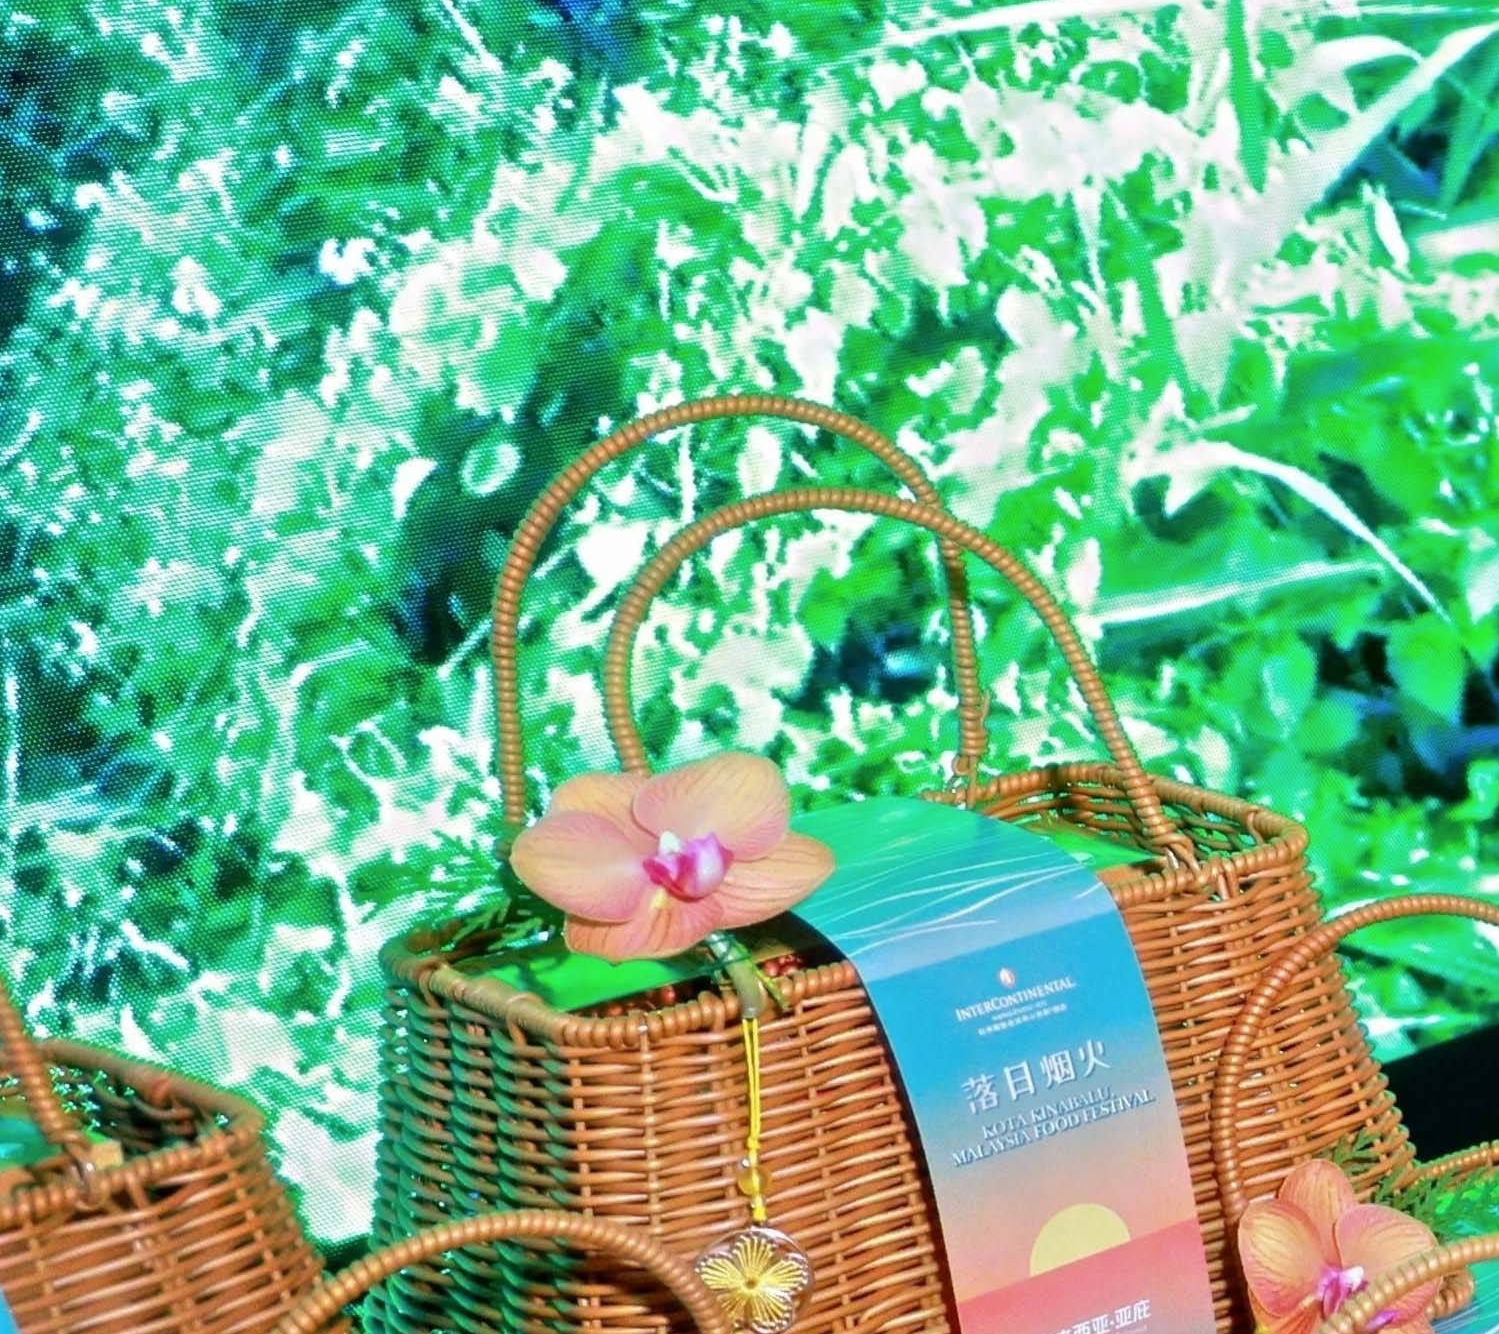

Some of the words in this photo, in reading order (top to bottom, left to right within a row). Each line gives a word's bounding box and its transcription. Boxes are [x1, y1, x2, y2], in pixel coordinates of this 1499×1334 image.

[962, 1039, 1111, 1114] 落日烟火
[952, 1131, 1032, 1166] MALAYSIA
[1034, 1113, 1086, 1139] FOOD
[1082, 1089, 1156, 1120] FESTIVAL
[983, 1114, 1028, 1140] KOTA
